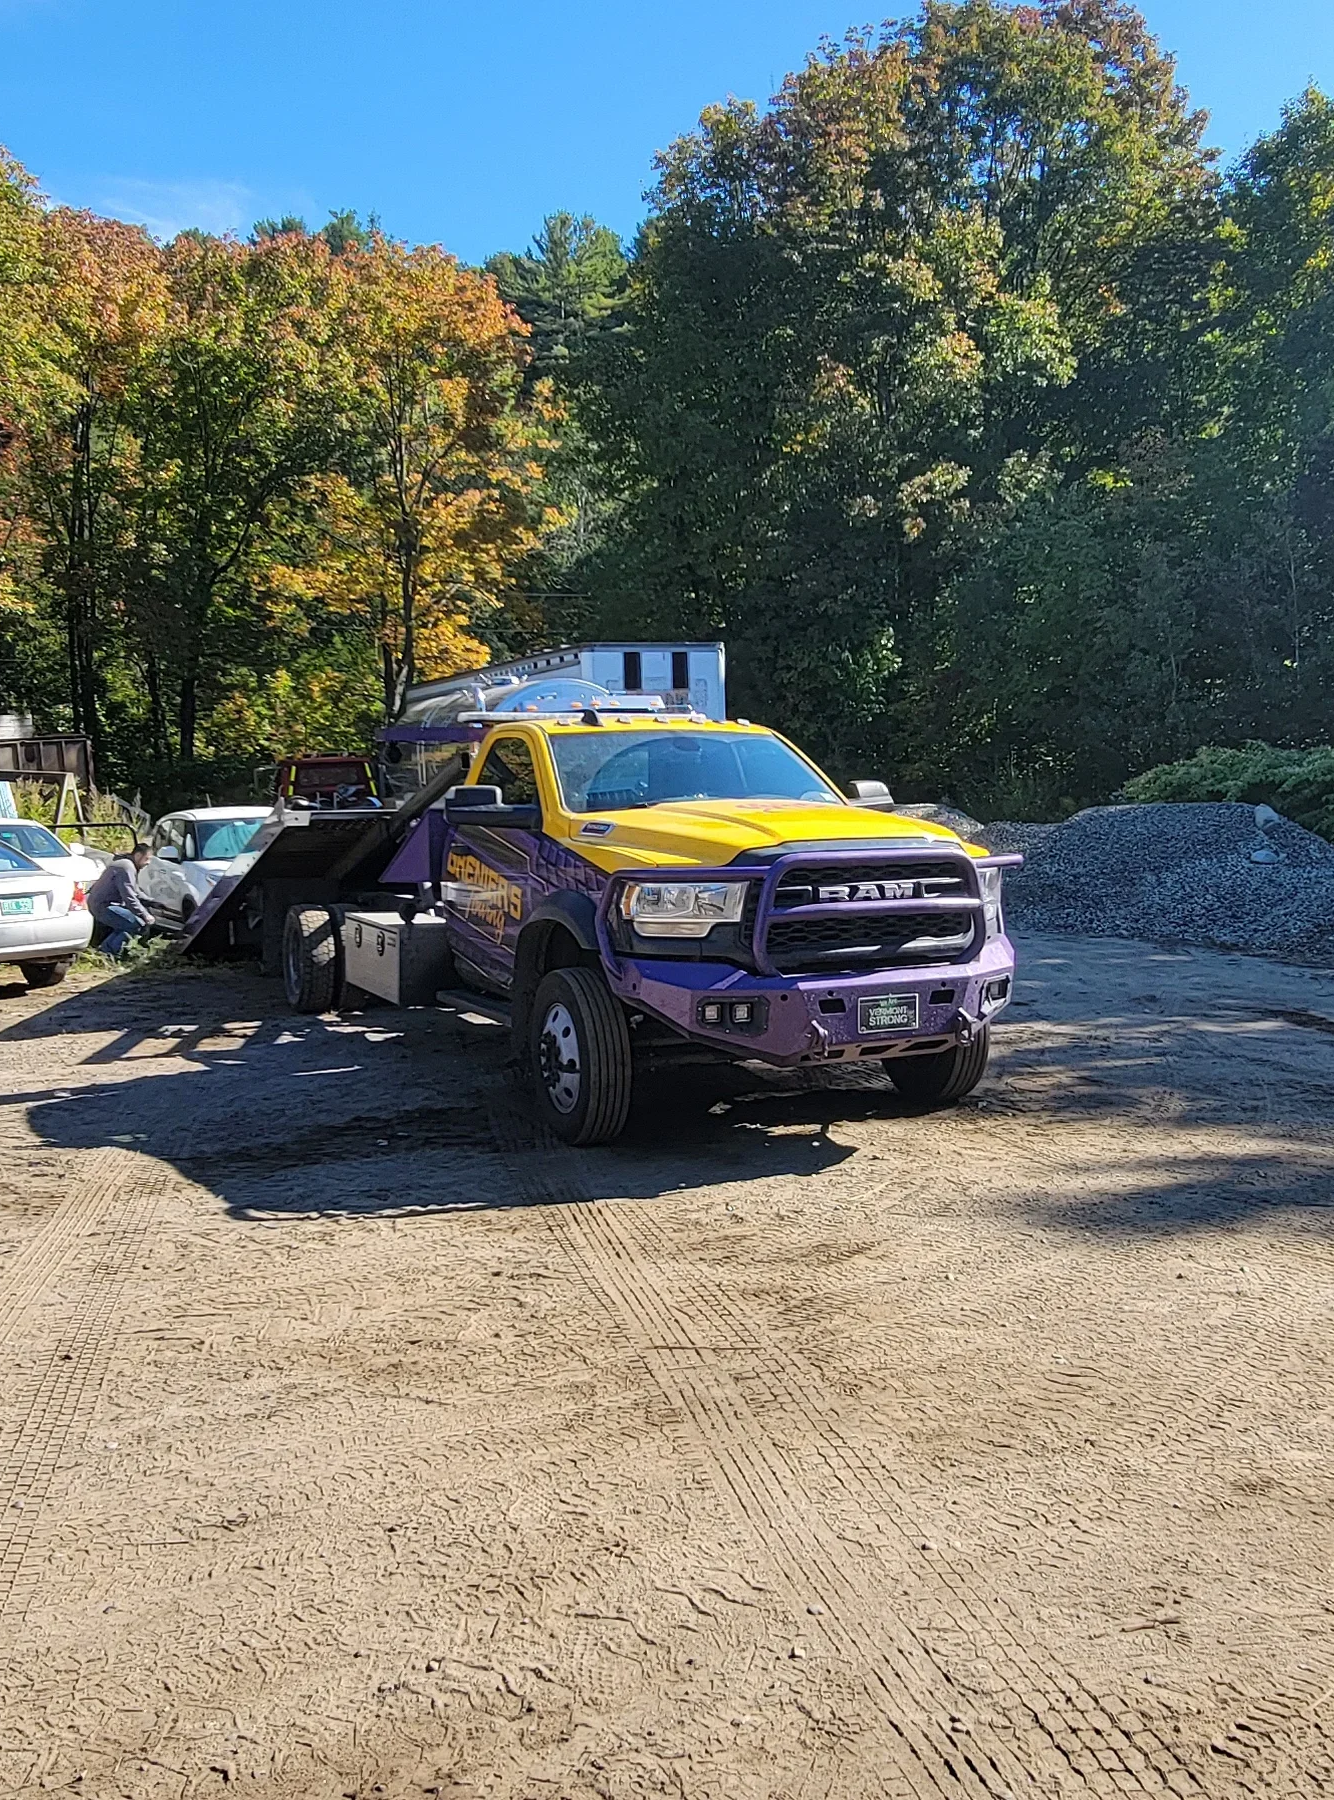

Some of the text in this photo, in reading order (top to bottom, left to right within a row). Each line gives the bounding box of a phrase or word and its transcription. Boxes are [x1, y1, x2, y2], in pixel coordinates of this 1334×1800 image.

[818, 883, 914, 901] RAM
[868, 1005, 908, 1016] VERMONT
[868, 1014, 908, 1026] STRONG
